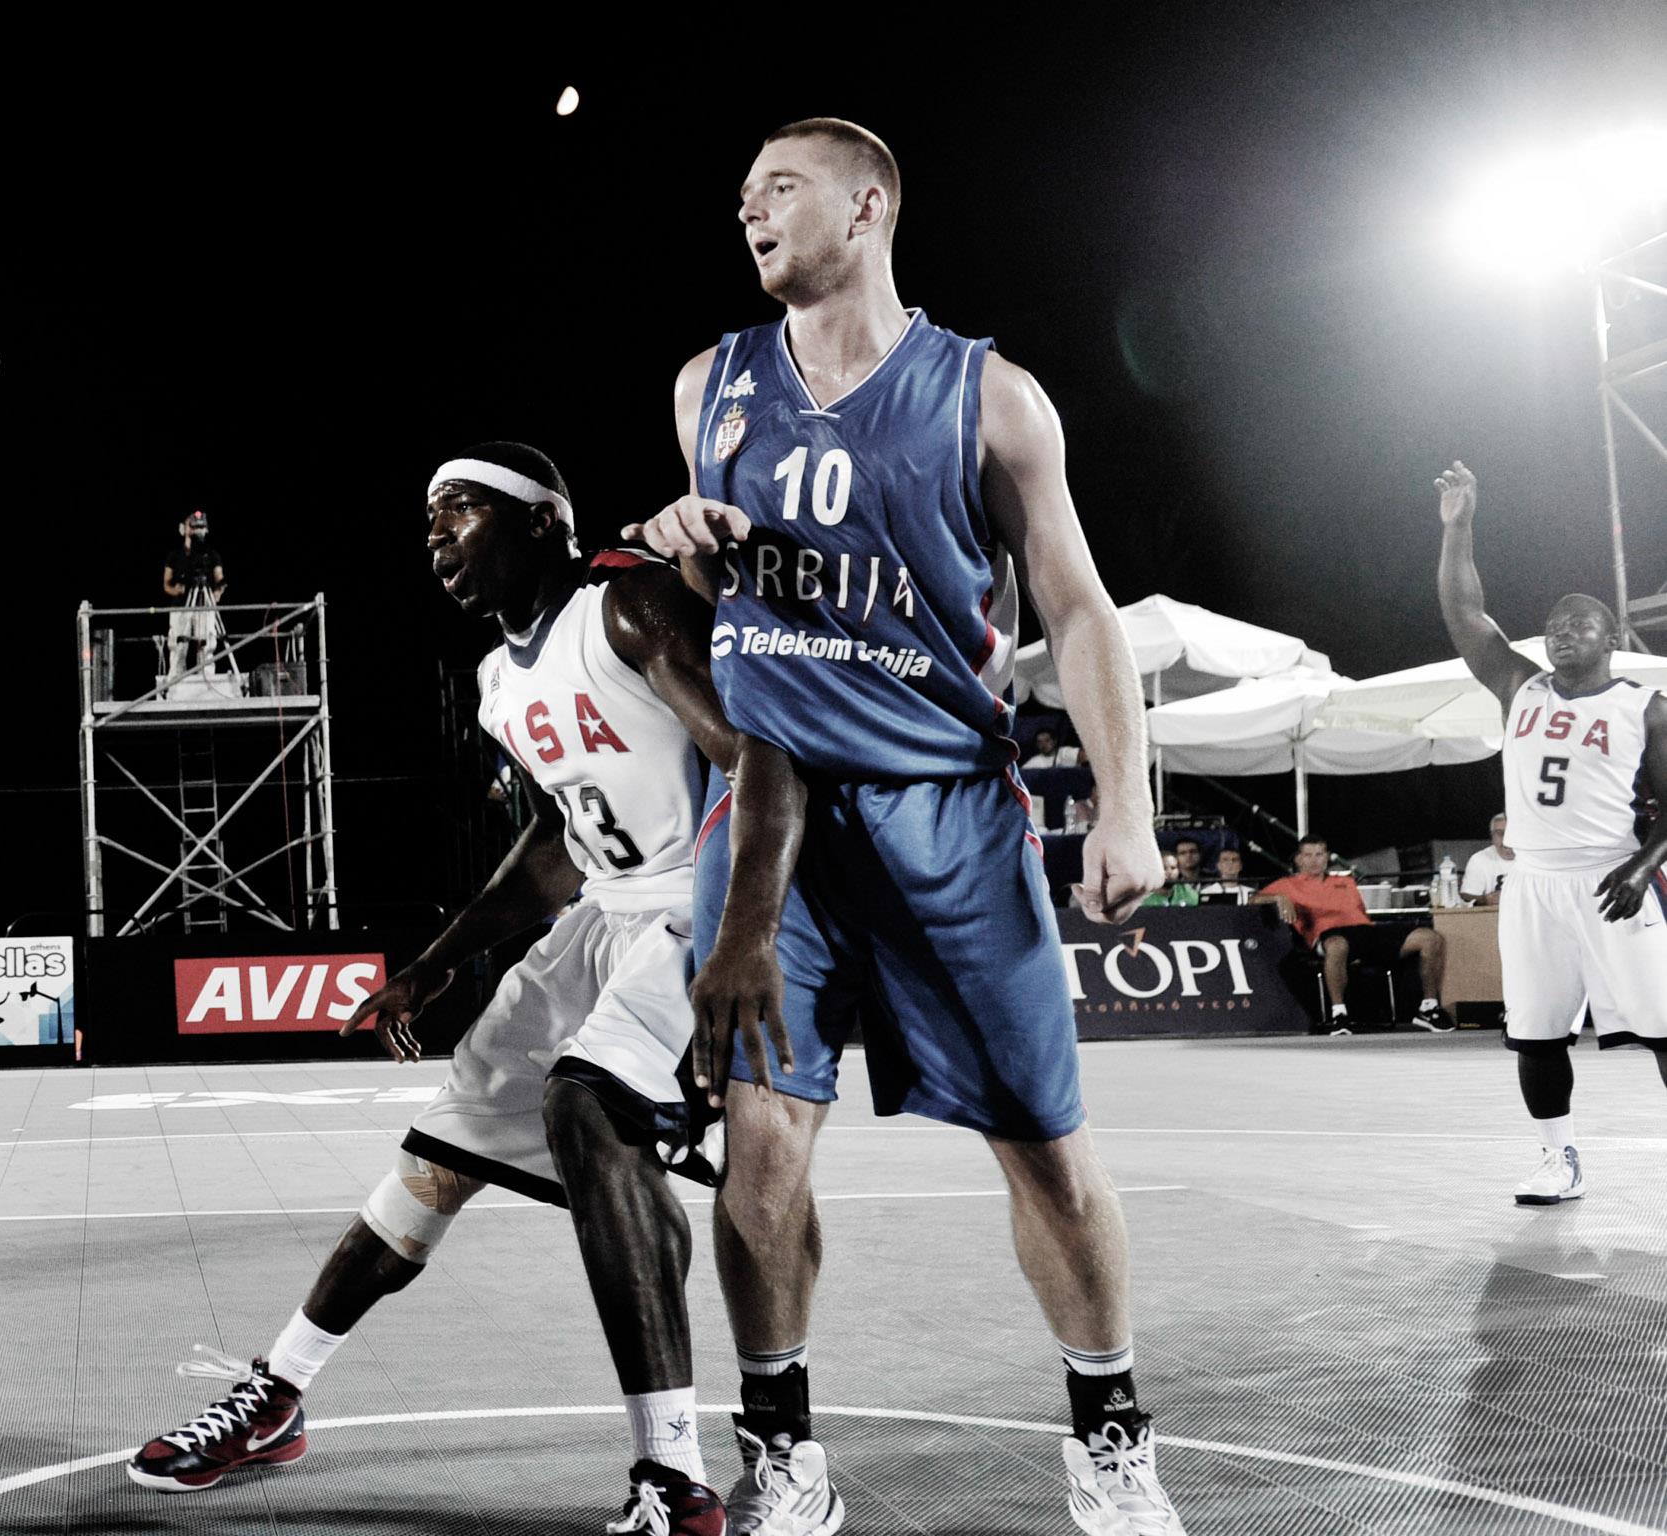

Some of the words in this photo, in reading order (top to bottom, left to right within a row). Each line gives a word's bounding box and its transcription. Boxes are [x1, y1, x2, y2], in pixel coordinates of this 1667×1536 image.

[774, 446, 853, 526] 10
[722, 541, 915, 622] SRBIJA
[740, 626, 853, 662] Telekom
[1514, 705, 1610, 757] USA
[1536, 755, 1571, 808] 5
[554, 784, 645, 871] 13
[185, 962, 378, 1023] AVIS
